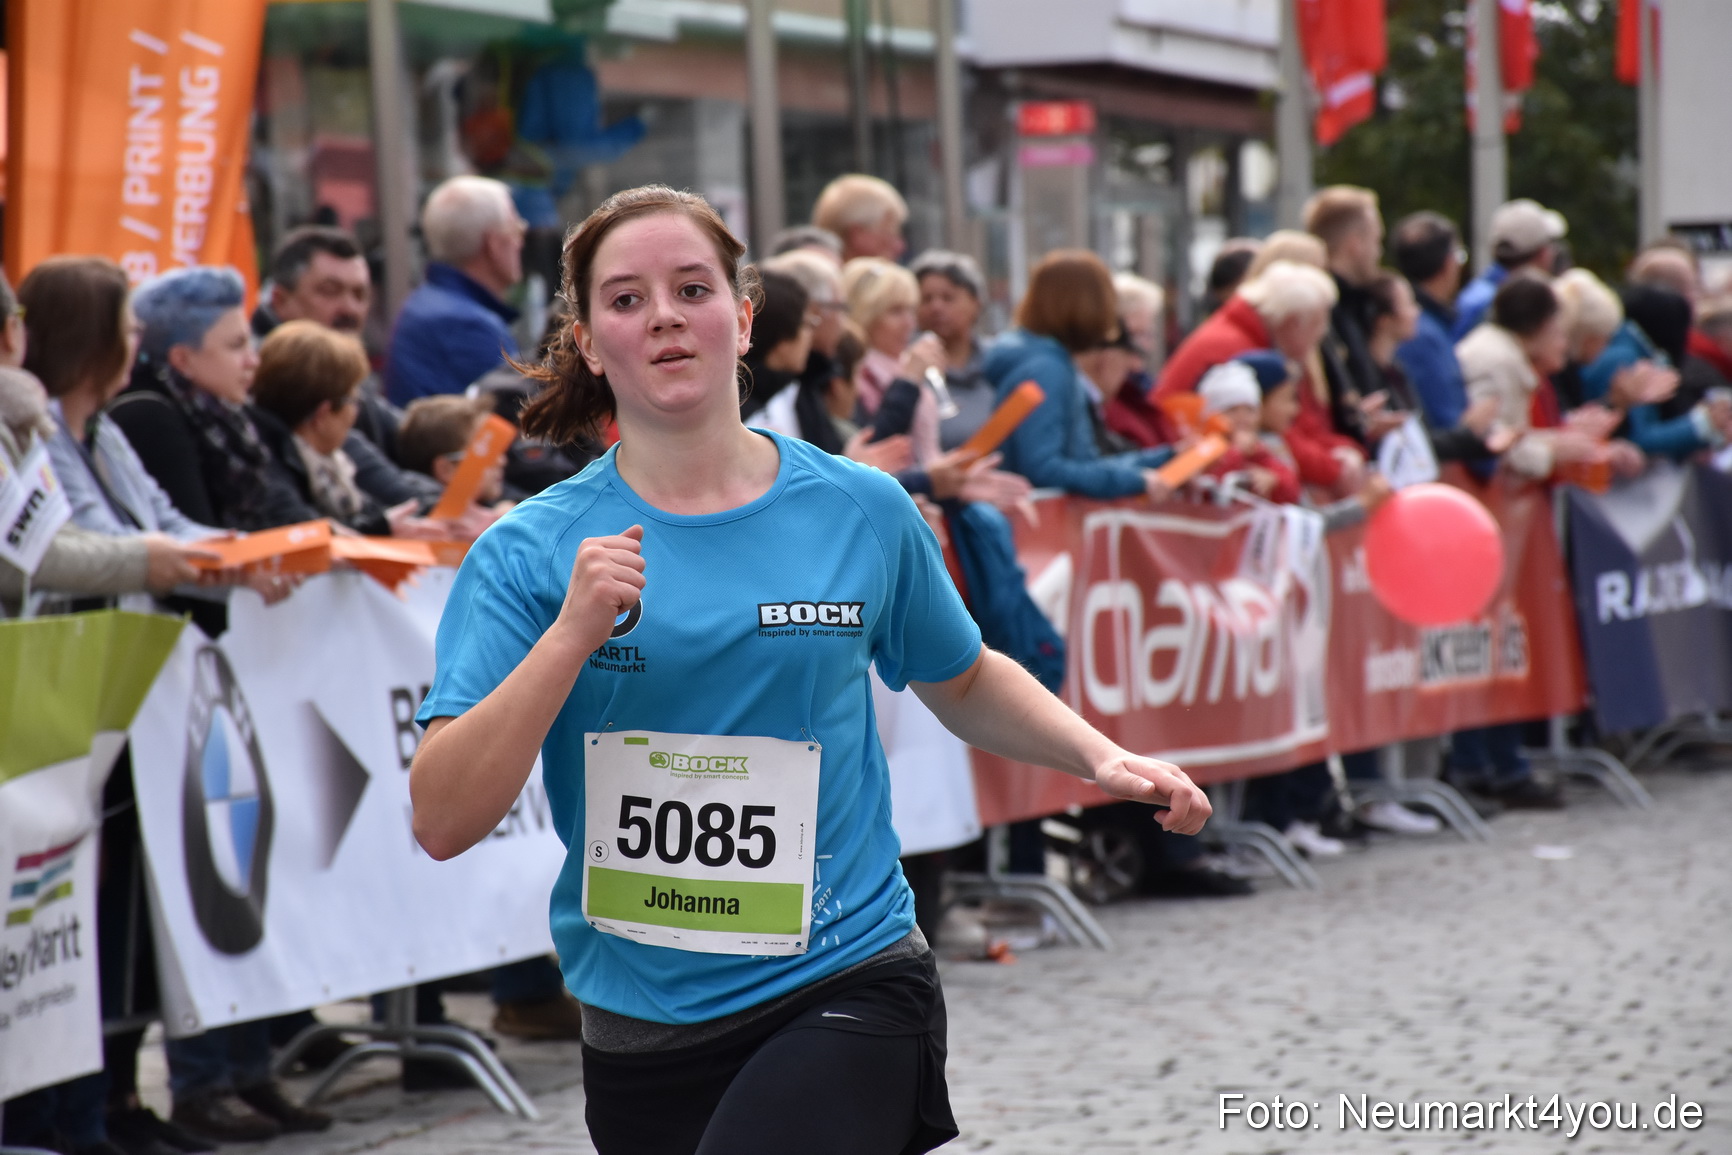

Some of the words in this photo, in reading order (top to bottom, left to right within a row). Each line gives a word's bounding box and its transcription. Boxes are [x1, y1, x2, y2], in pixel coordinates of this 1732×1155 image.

[122, 64, 164, 205] PRINT
[758, 602, 865, 627] BOCK
[758, 628, 796, 638] inspired
[799, 628, 810, 638] by
[813, 629, 835, 637] smart
[836, 629, 863, 638] concepts
[590, 658, 646, 673] Neumarkt
[671, 753, 749, 774] BOCK
[670, 771, 693, 779] inspired
[616, 795, 776, 869] 5085
[595, 846, 603, 858] S
[644, 886, 740, 915] Johanna
[814, 887, 833, 911] 2017
